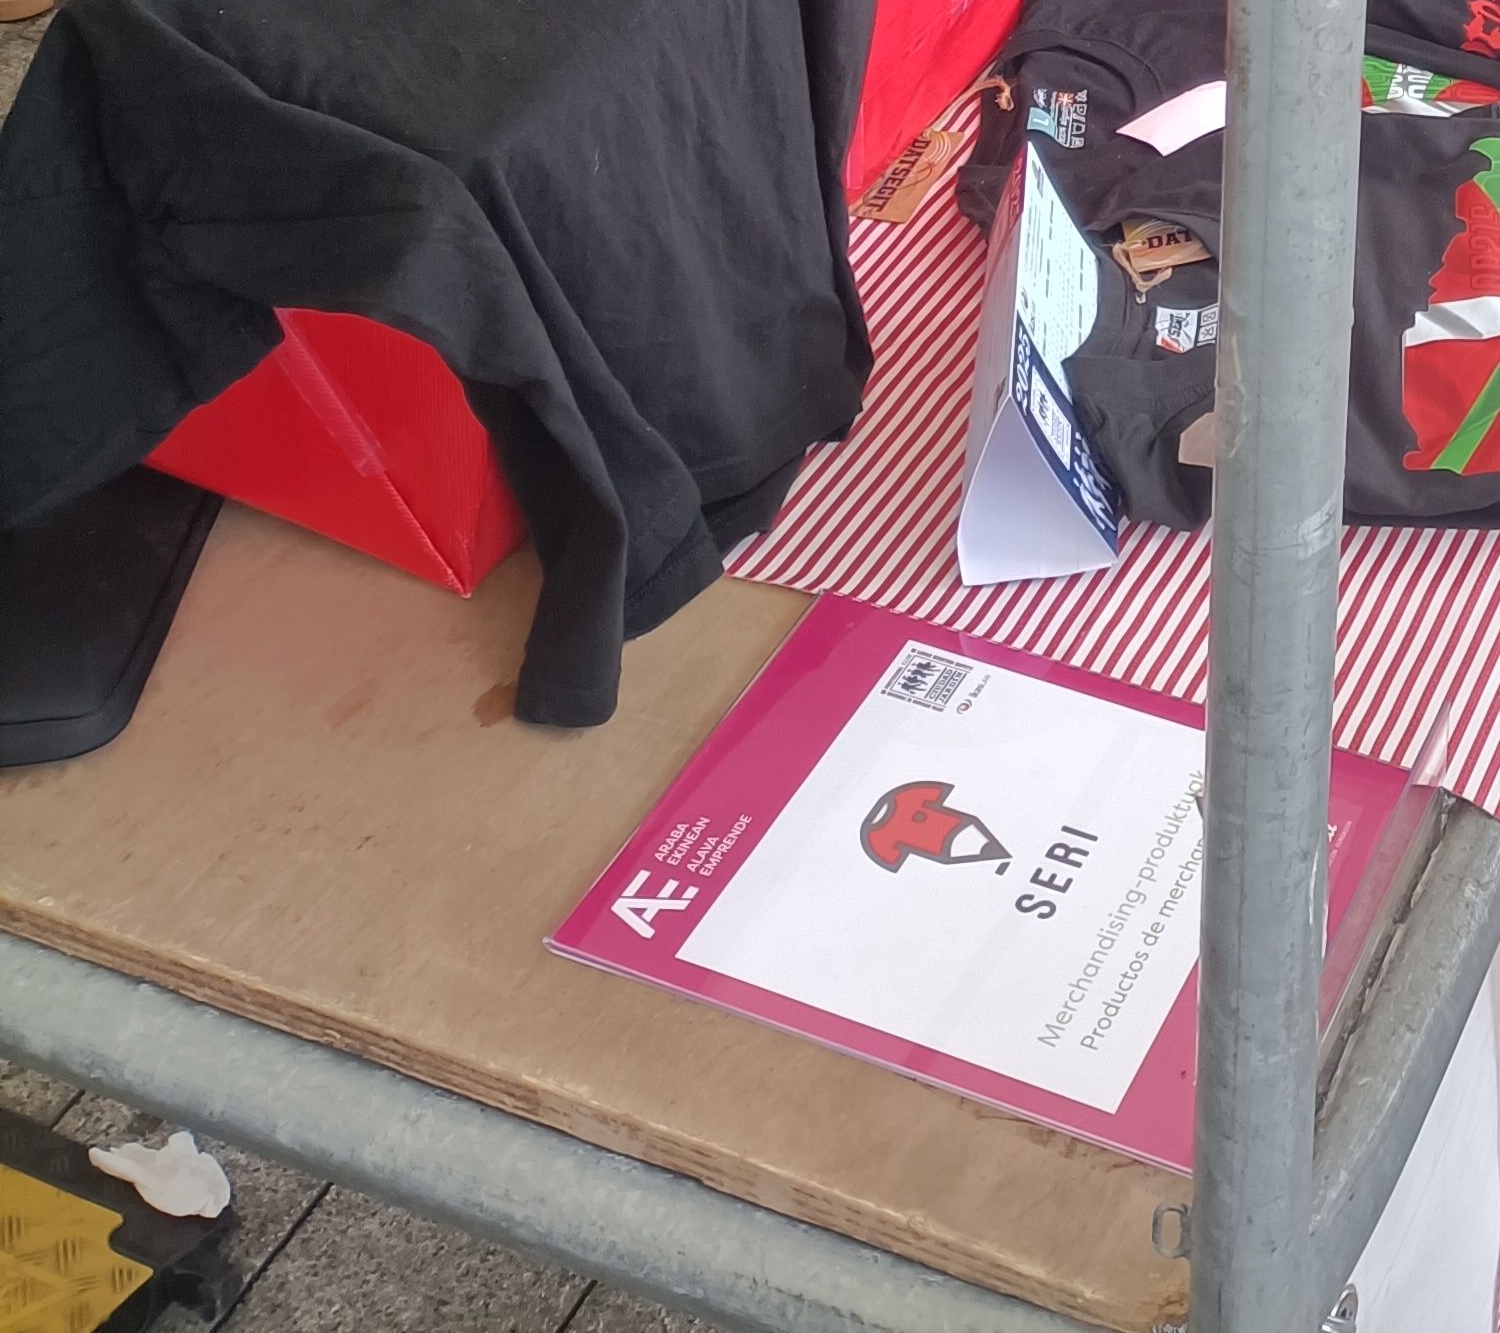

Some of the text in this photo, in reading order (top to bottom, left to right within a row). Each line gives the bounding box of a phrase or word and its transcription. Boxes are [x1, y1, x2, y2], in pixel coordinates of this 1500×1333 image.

[865, 134, 933, 213] DATSEGIT
[1015, 324, 1032, 417] 2025
[929, 669, 953, 700] CIUDAD
[654, 822, 690, 862] ARABA
[667, 816, 711, 866] EKINEAN
[699, 813, 753, 877] EMPRENDE
[1014, 825, 1099, 920] SERI
[1080, 950, 1149, 1051] Productos
[1141, 921, 1165, 947] de
